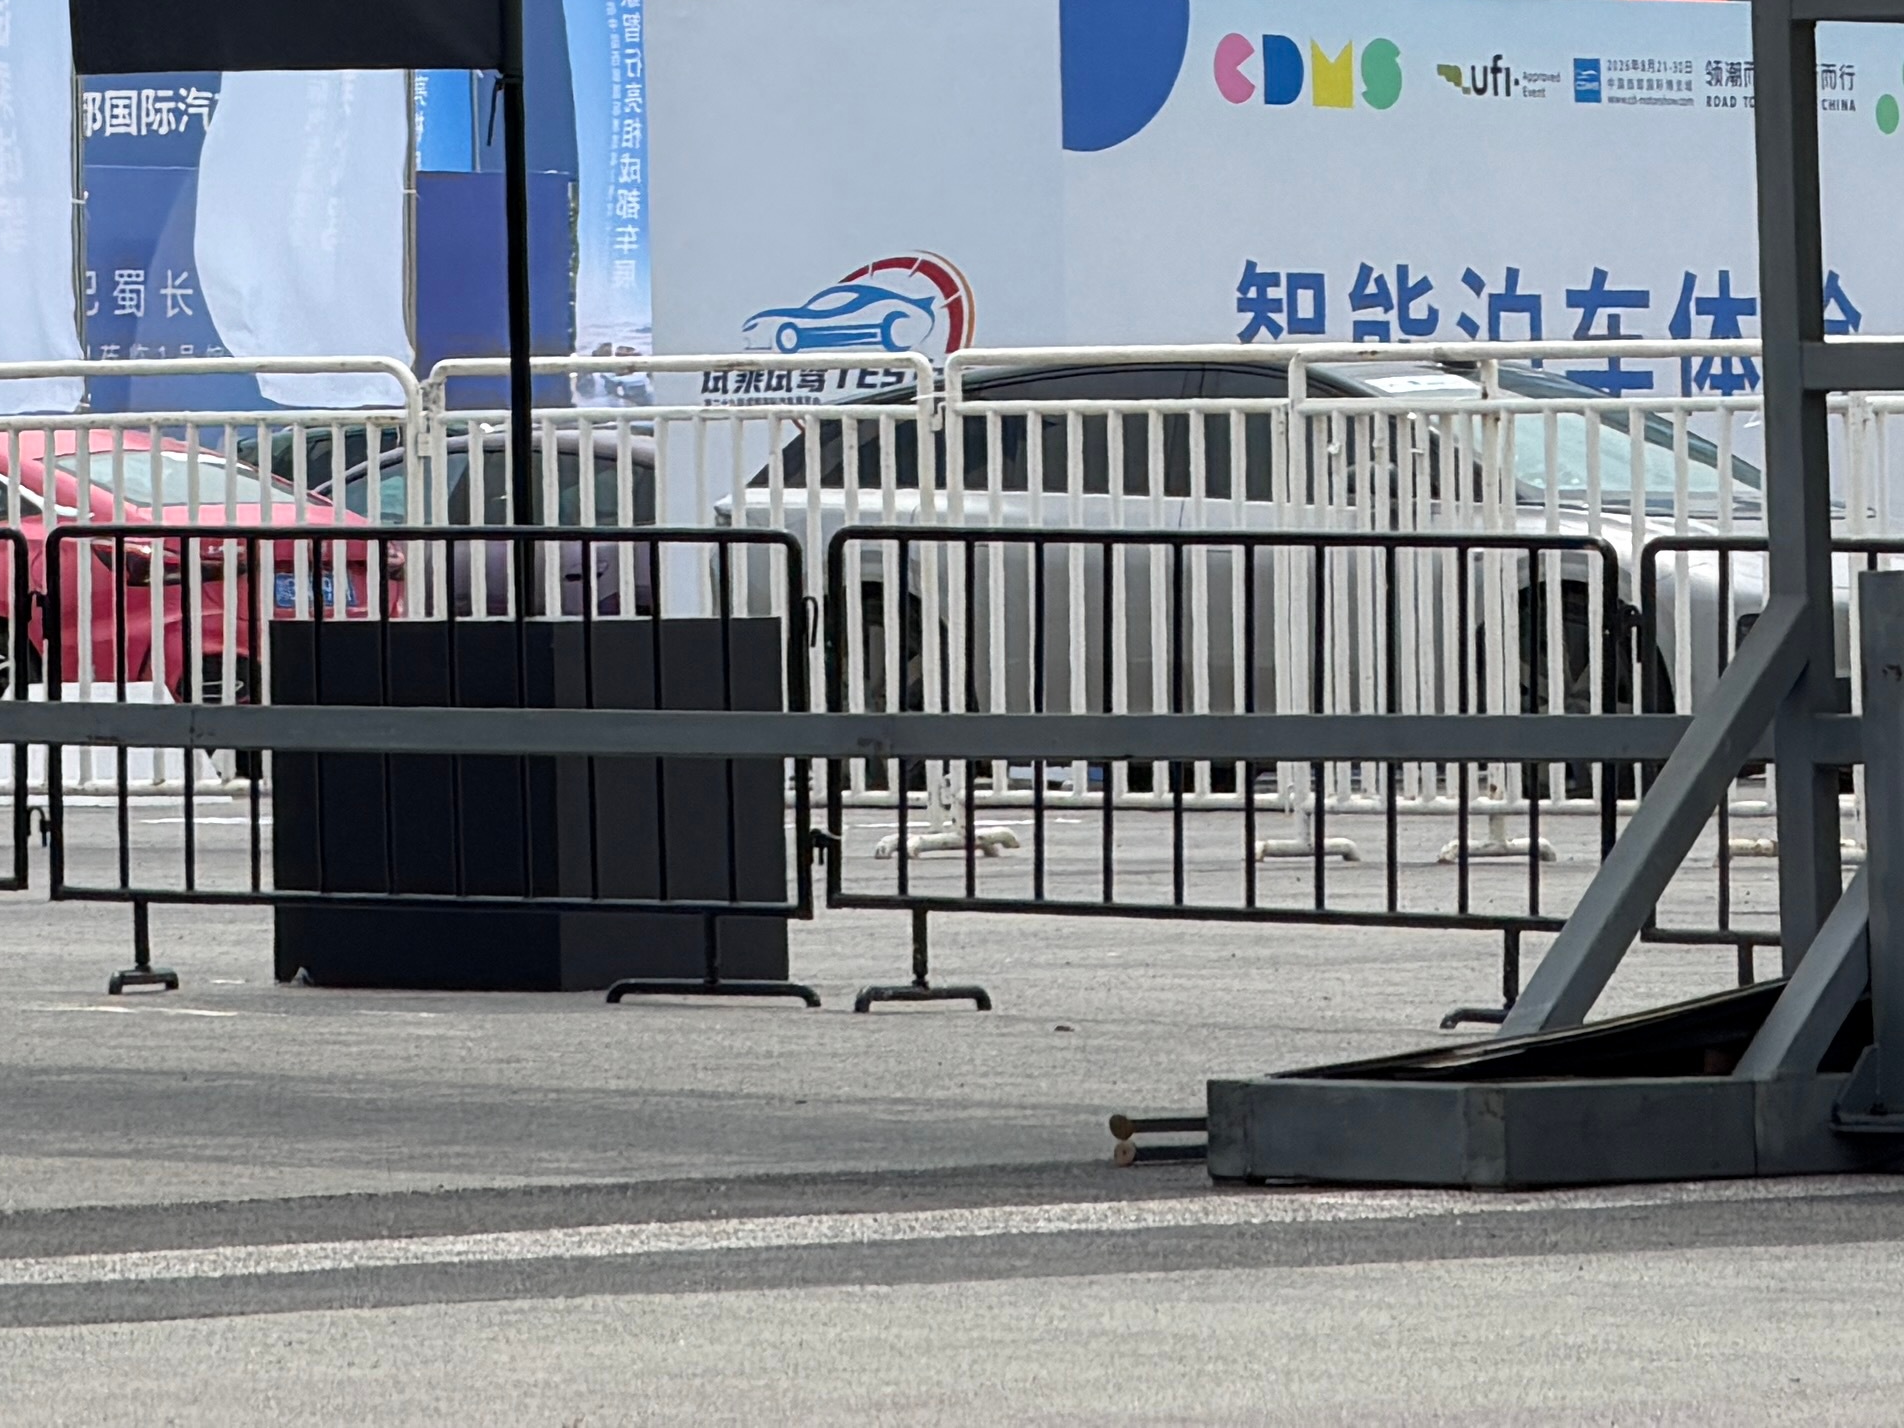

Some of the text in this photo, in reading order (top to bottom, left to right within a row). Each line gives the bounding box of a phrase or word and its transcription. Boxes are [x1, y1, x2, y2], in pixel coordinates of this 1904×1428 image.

[1213, 32, 1403, 110] CDMS
[1705, 95, 1737, 108] ROAD
[1821, 97, 1856, 111] CHINA
